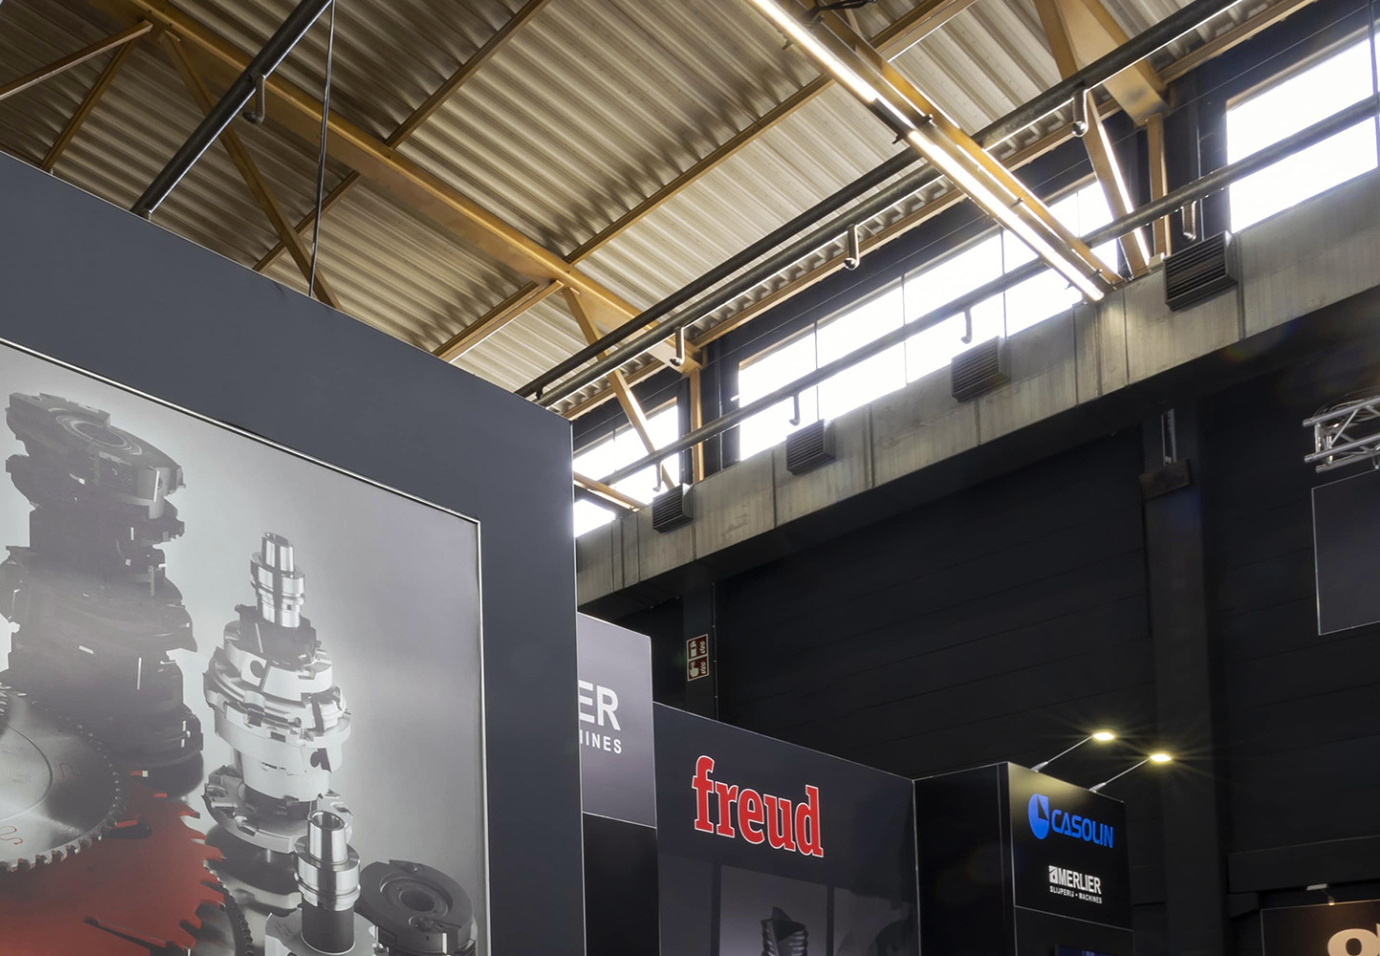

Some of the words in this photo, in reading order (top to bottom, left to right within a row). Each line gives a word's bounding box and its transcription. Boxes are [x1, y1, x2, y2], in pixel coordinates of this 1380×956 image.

[693, 755, 824, 858] freud
[1051, 809, 1114, 848] CASOLIN
[1058, 867, 1102, 894] MERLIER
